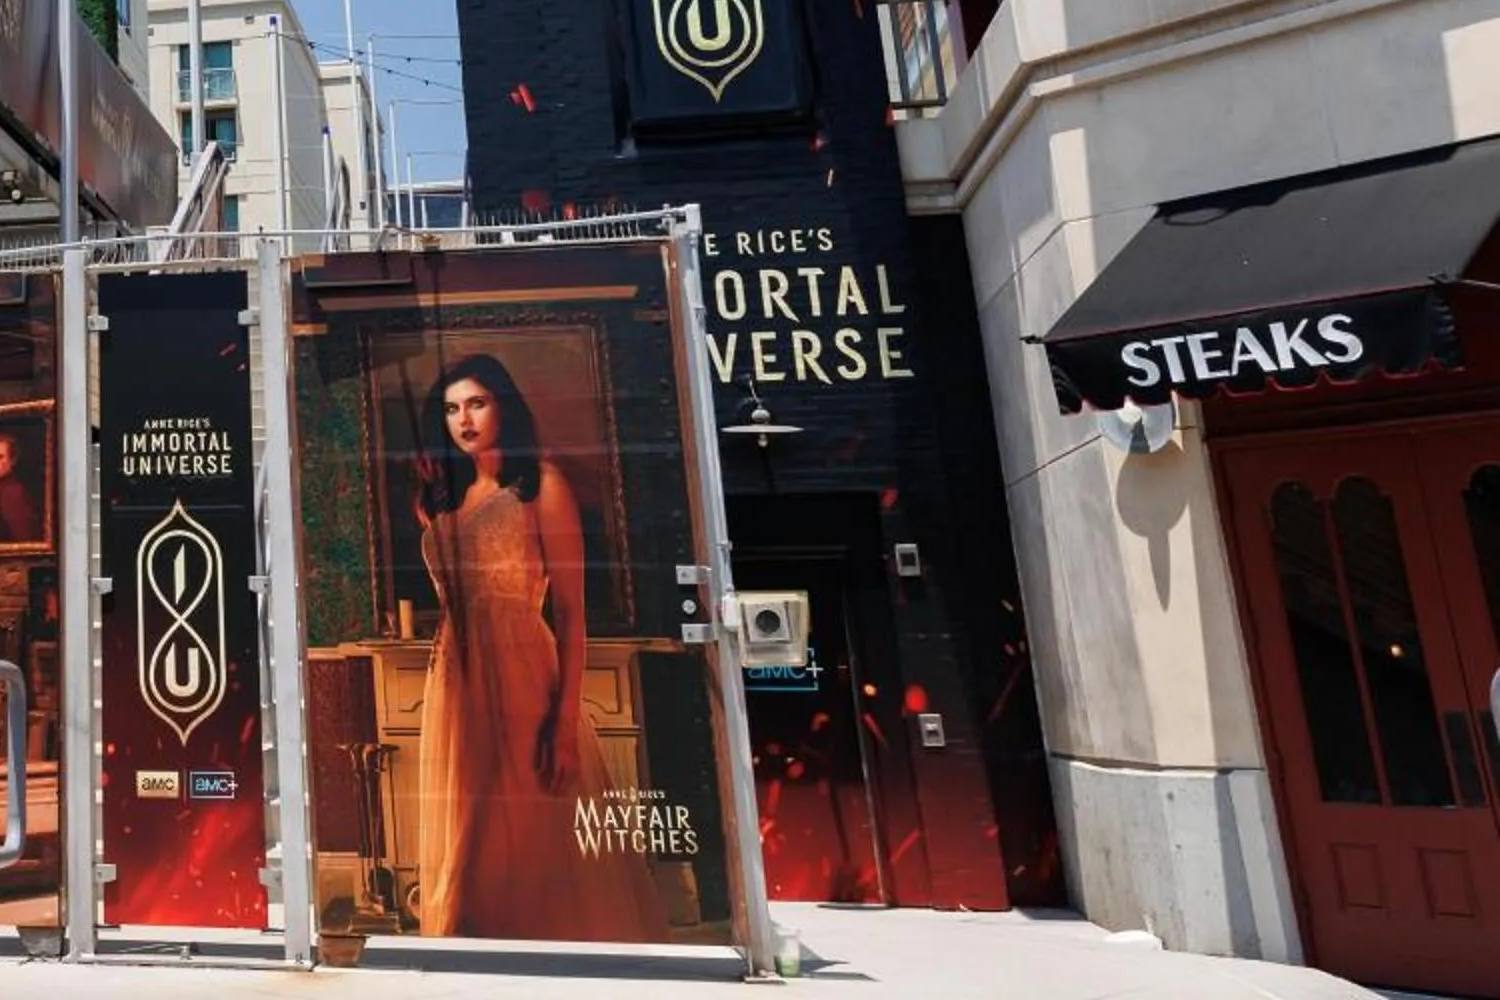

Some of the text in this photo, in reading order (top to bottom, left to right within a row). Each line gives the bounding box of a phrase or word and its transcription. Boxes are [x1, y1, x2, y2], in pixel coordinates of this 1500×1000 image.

[736, 227, 834, 257] RICE'S
[714, 264, 907, 322] ORTAL
[705, 327, 916, 385] VERSE
[1120, 313, 1364, 387] STEAKS
[123, 432, 232, 454] IMMORTAL
[123, 454, 233, 476] UNIVERSE
[574, 796, 691, 829] MAYFAIR
[573, 828, 699, 860] WITCHES
